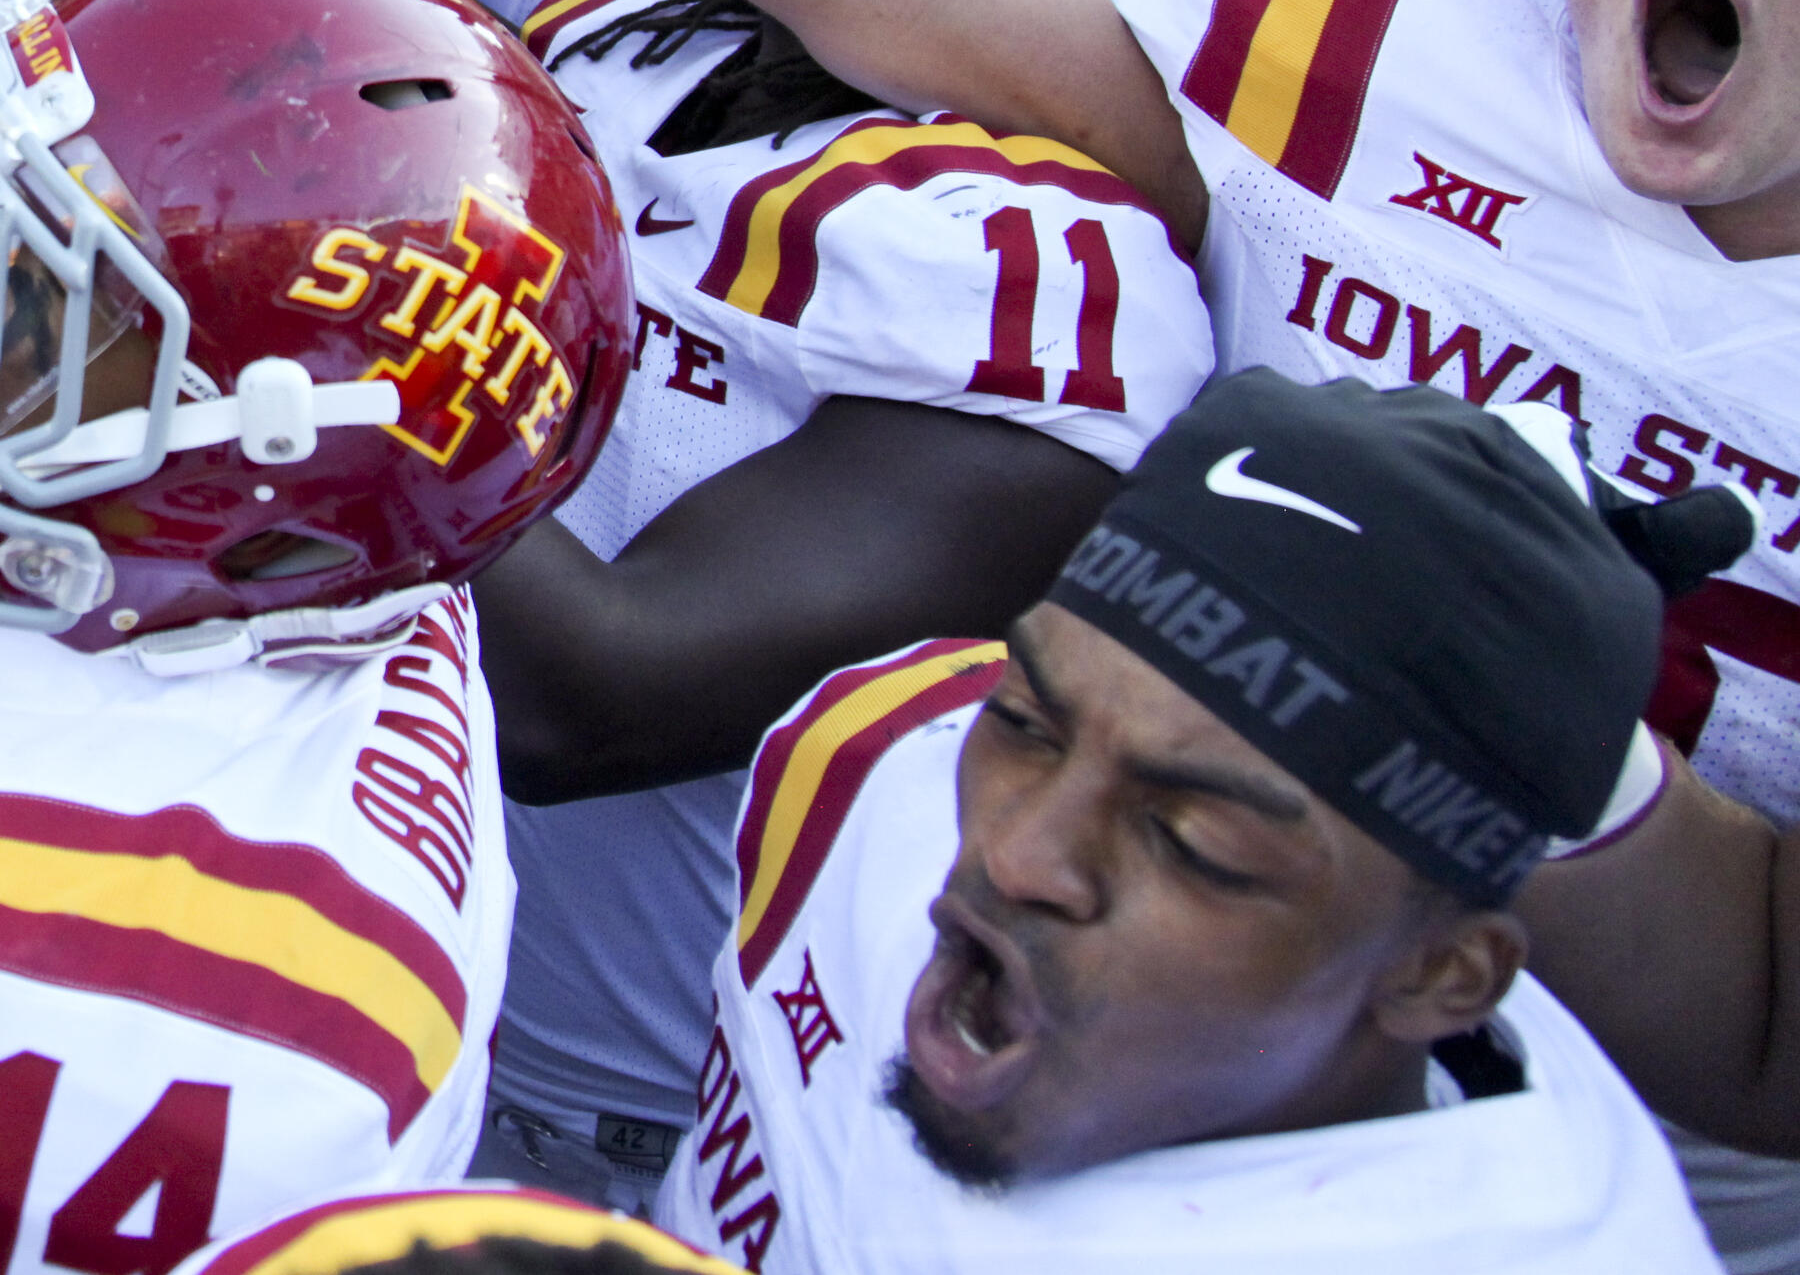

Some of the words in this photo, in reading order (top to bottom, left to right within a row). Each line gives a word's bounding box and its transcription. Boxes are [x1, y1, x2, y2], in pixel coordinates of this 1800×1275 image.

[1388, 150, 1528, 251] XII
[286, 227, 575, 459] STATE
[966, 206, 1127, 413] 11
[1286, 253, 1592, 429] IOWA
[1354, 739, 1532, 872] NIKE
[773, 948, 843, 1087] XII
[610, 1126, 646, 1150] 42
